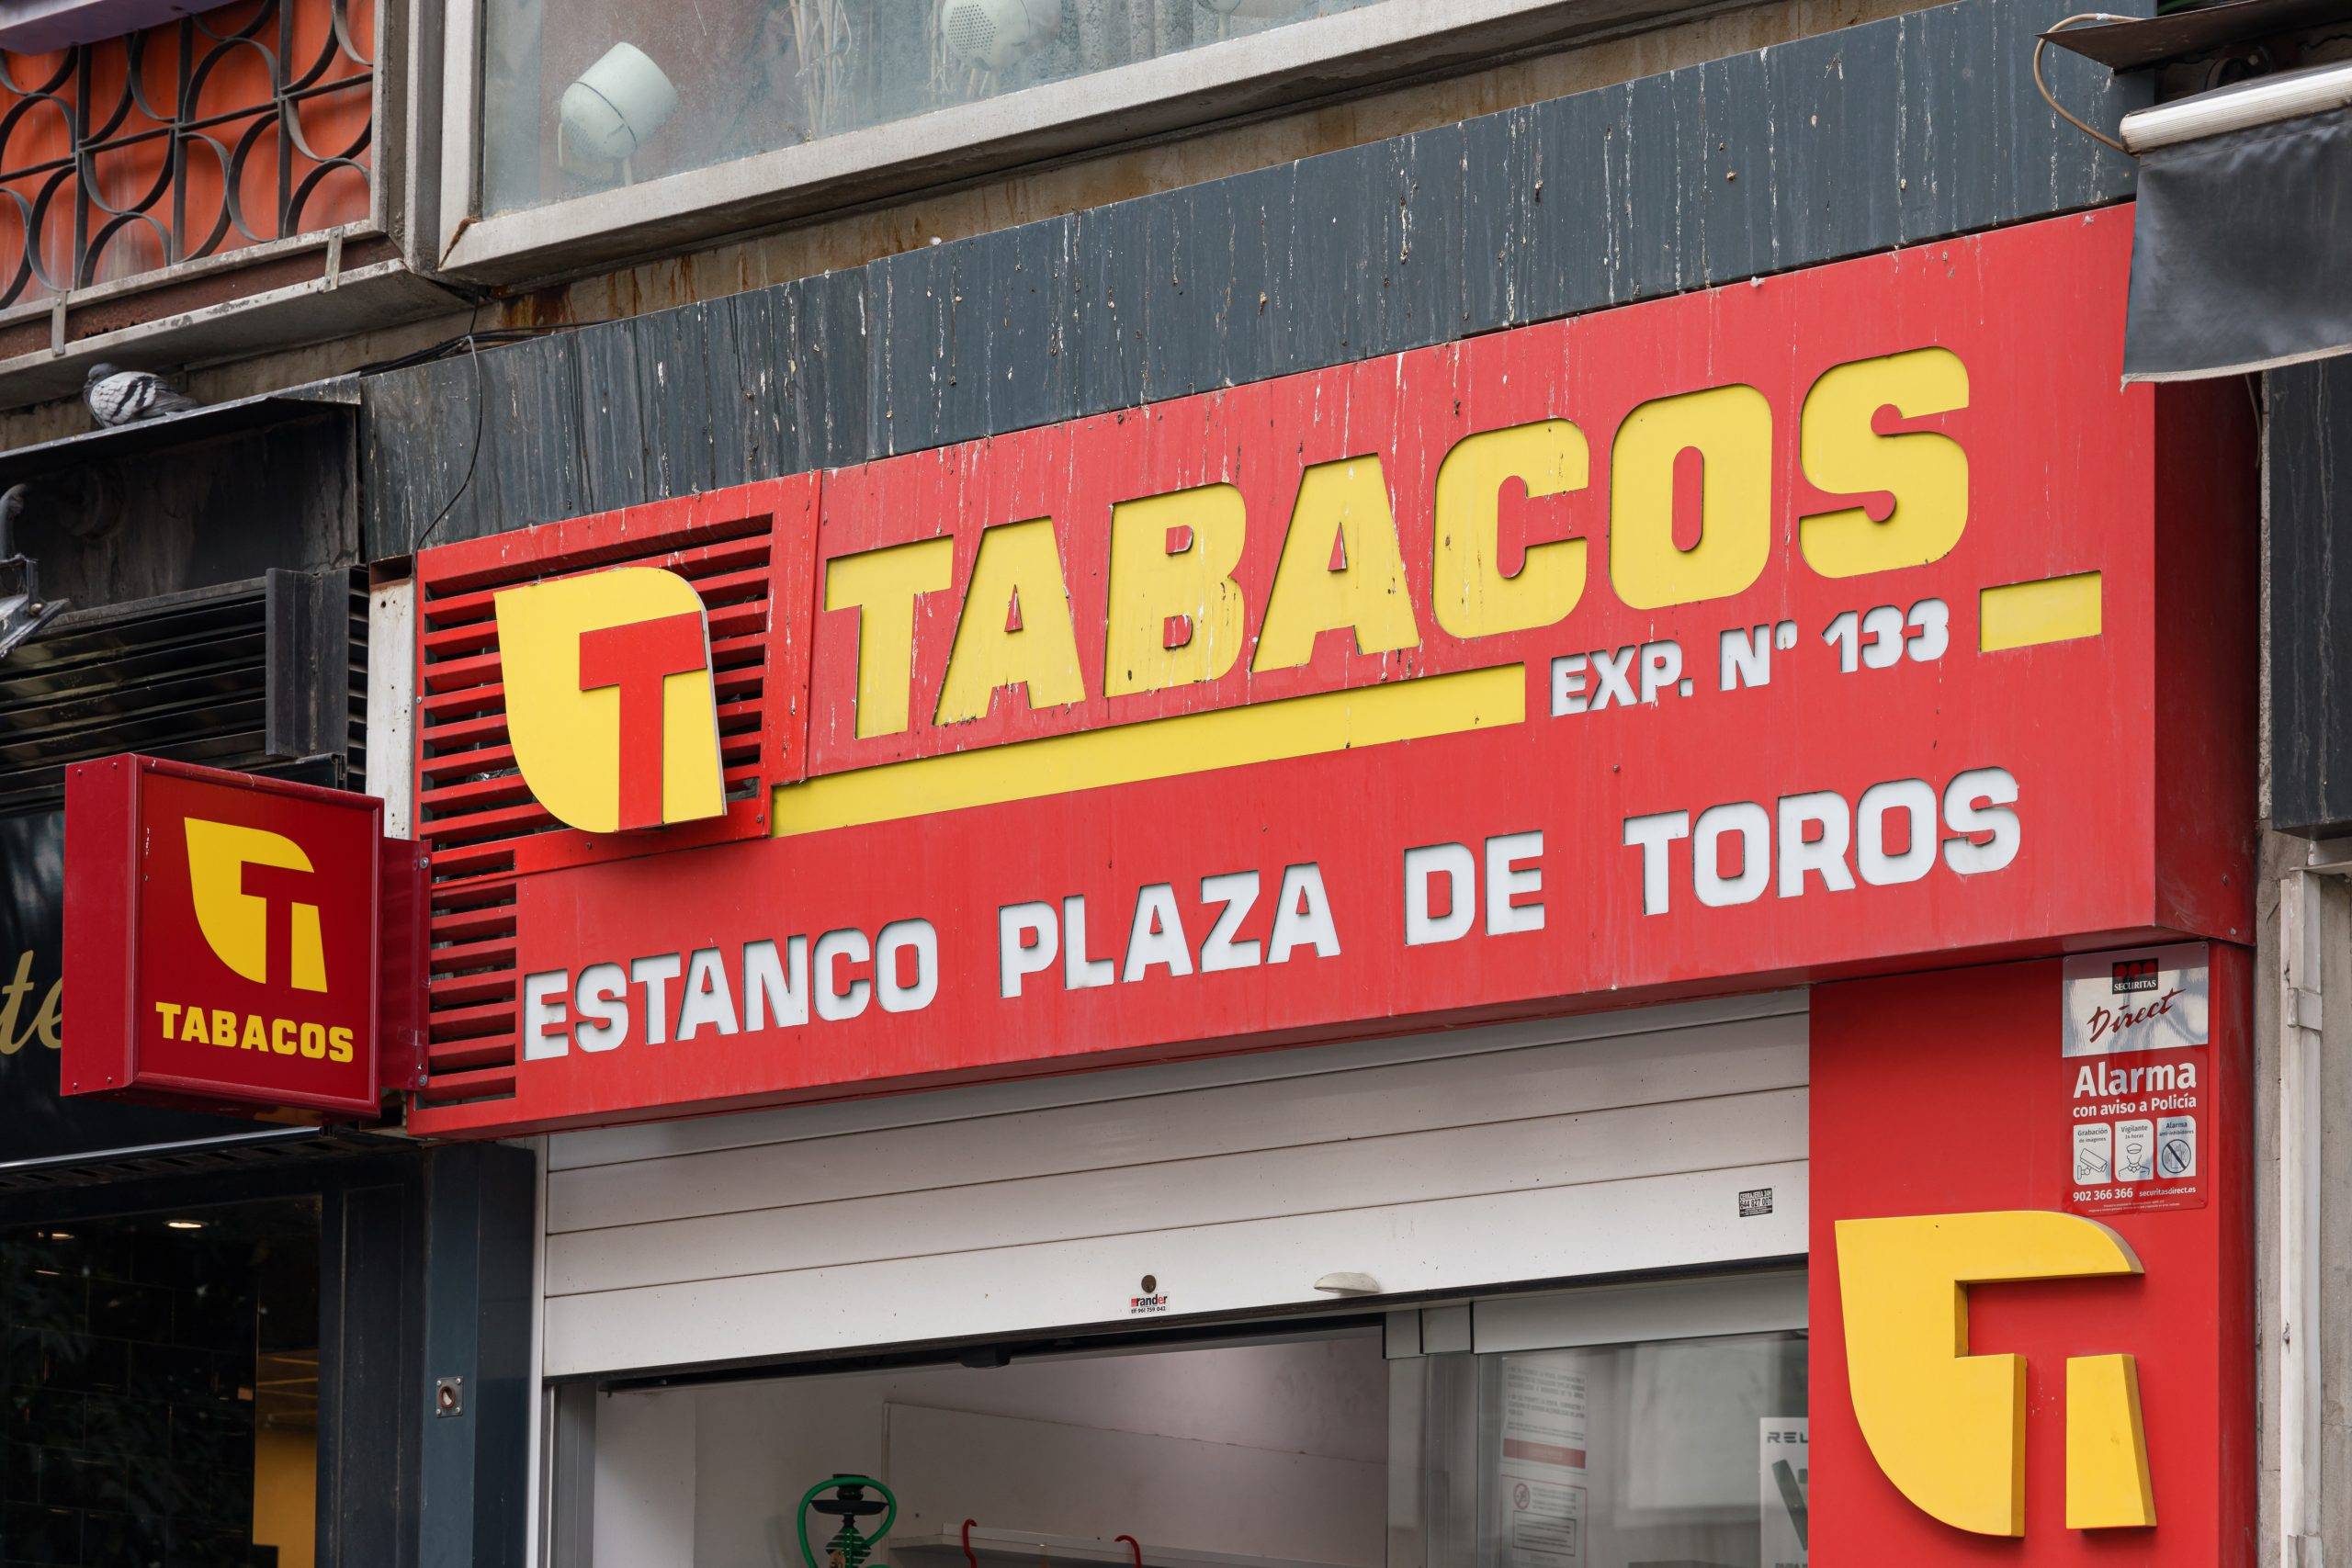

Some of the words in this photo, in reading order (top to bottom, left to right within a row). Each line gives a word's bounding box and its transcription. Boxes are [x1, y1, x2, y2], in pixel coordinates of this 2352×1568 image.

[823, 345, 1969, 739] TABACOS
[1551, 639, 1693, 716] EXP.
[1821, 597, 1950, 674] 133
[523, 917, 938, 1061] ESTANCO
[998, 862, 1341, 998] PLAZA
[1404, 829, 1545, 947] DE
[1623, 767, 2021, 917] TOROS
[2114, 979, 2156, 991] SECURITAS
[2086, 987, 2187, 1043] Direct
[155, 1001, 354, 1064] TABACOS
[2073, 1061, 2197, 1099] Alarma
[2073, 1104, 2098, 1119] con
[2099, 1100, 2135, 1115] aviso
[2140, 1101, 2148, 1111] a
[2151, 1093, 2197, 1111] Policía
[2077, 1128, 2108, 1136] Grabación
[2120, 1124, 2148, 1134] Vigilante
[2165, 1121, 2188, 1129] Alarma
[2073, 1190, 2091, 1202] 902
[2094, 1189, 2112, 1201] 366
[2114, 1187, 2133, 1199] 366
[2139, 1186, 2197, 1197] securitasdirect.es
